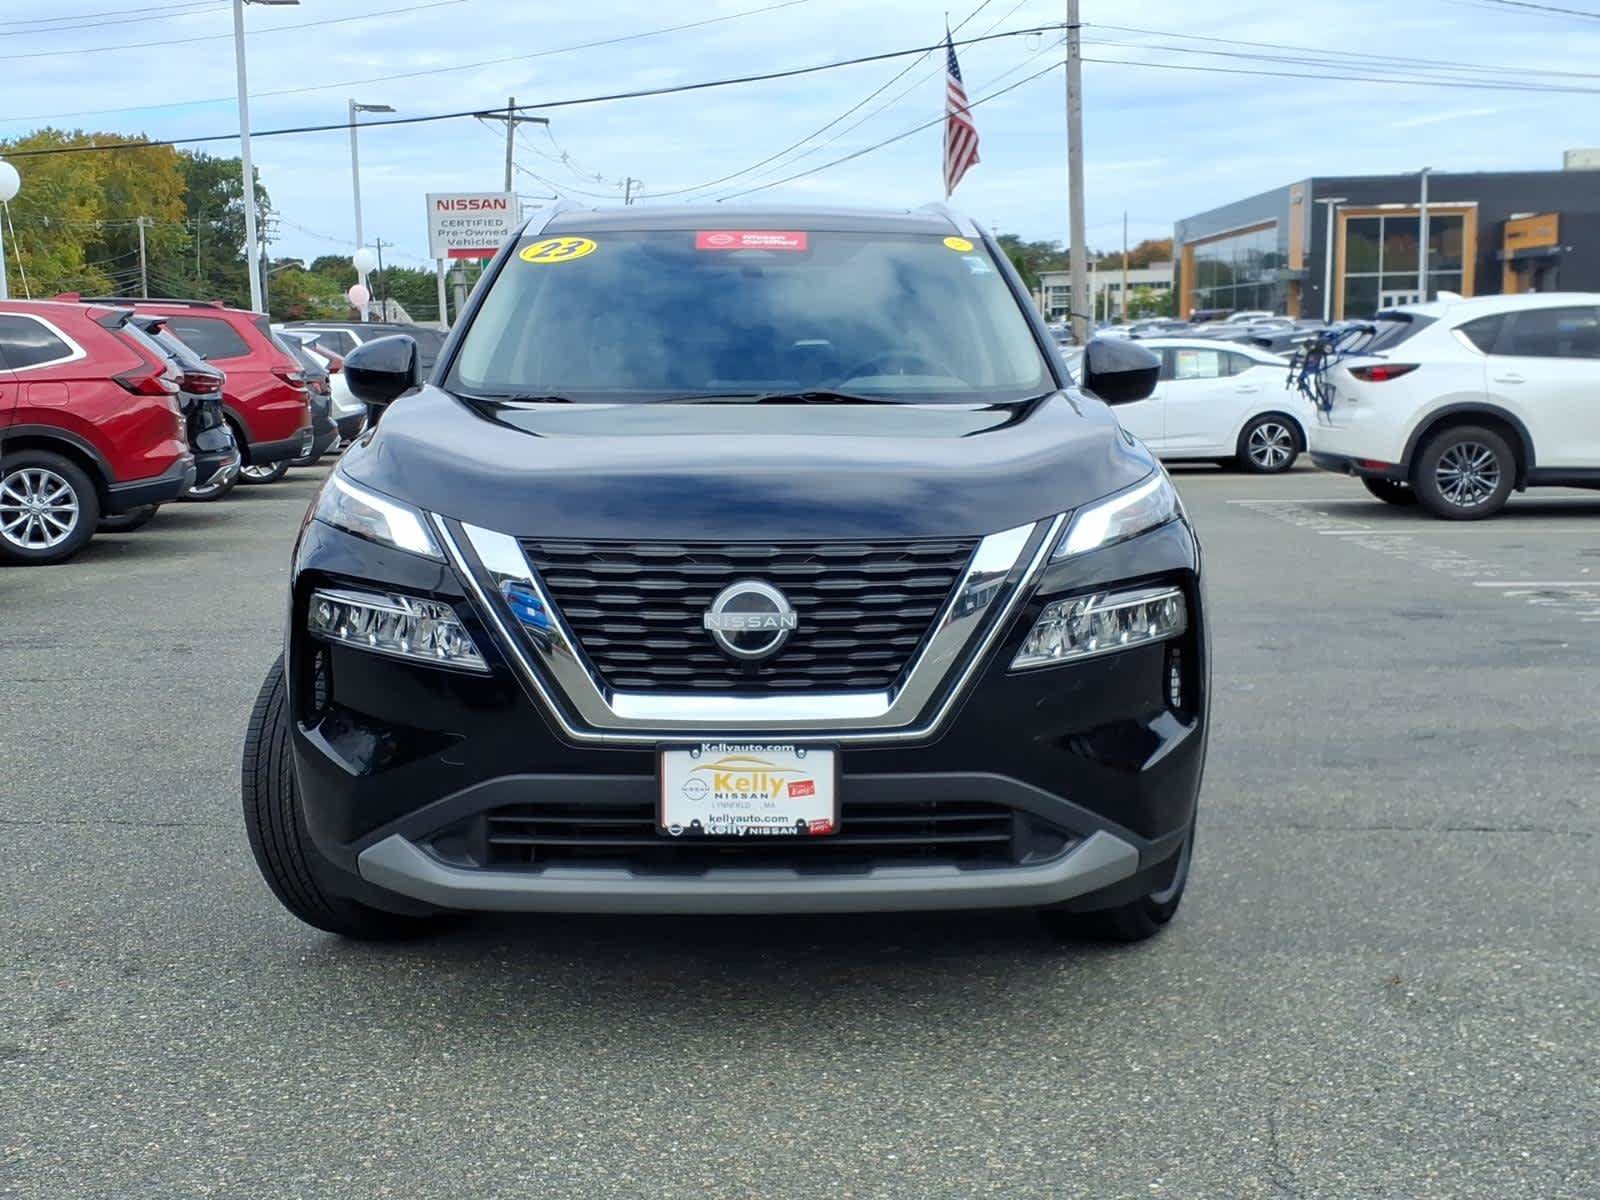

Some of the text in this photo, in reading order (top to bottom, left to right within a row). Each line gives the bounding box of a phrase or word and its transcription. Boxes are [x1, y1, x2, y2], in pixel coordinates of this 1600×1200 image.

[437, 199, 506, 210] NISSAN
[441, 219, 503, 227] CERTIFIED
[530, 241, 584, 258] 23
[707, 616, 794, 628] NISSAN
[702, 744, 795, 752] Kellyauto.com
[714, 772, 784, 798] Kelly
[709, 814, 788, 823] kellyauto.com
[704, 824, 797, 836] Kelly NISSAN
